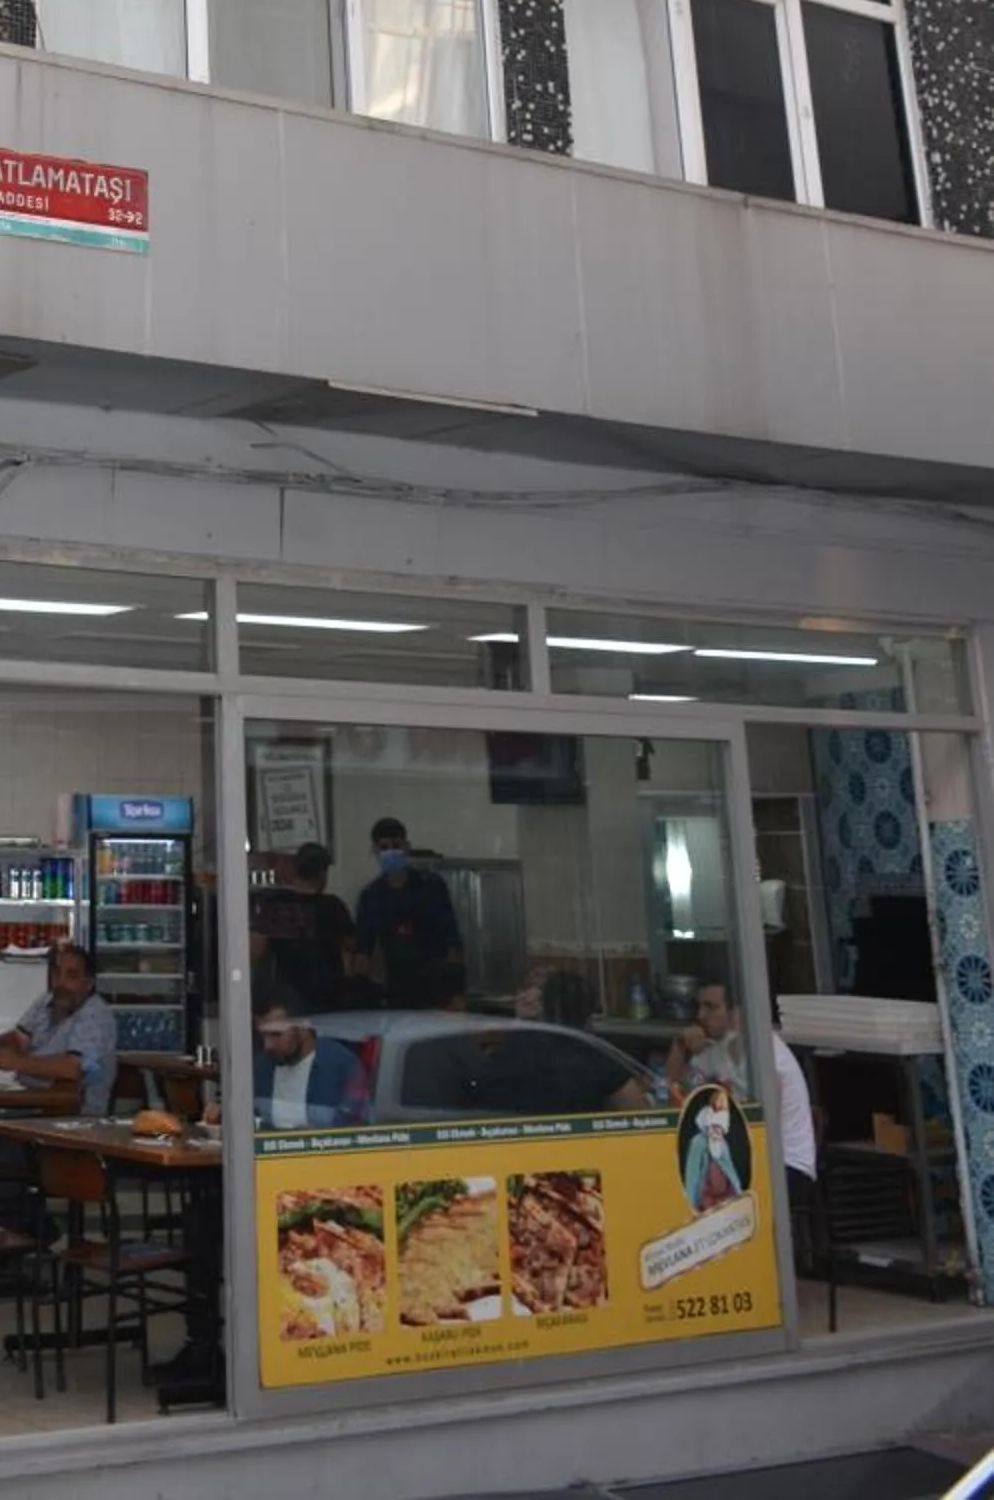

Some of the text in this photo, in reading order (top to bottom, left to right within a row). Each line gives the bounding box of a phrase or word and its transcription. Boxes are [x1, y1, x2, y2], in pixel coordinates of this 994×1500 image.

[676, 1296, 706, 1319] 522
[709, 1295, 729, 1316] 81
[733, 1291, 753, 1313] 03
